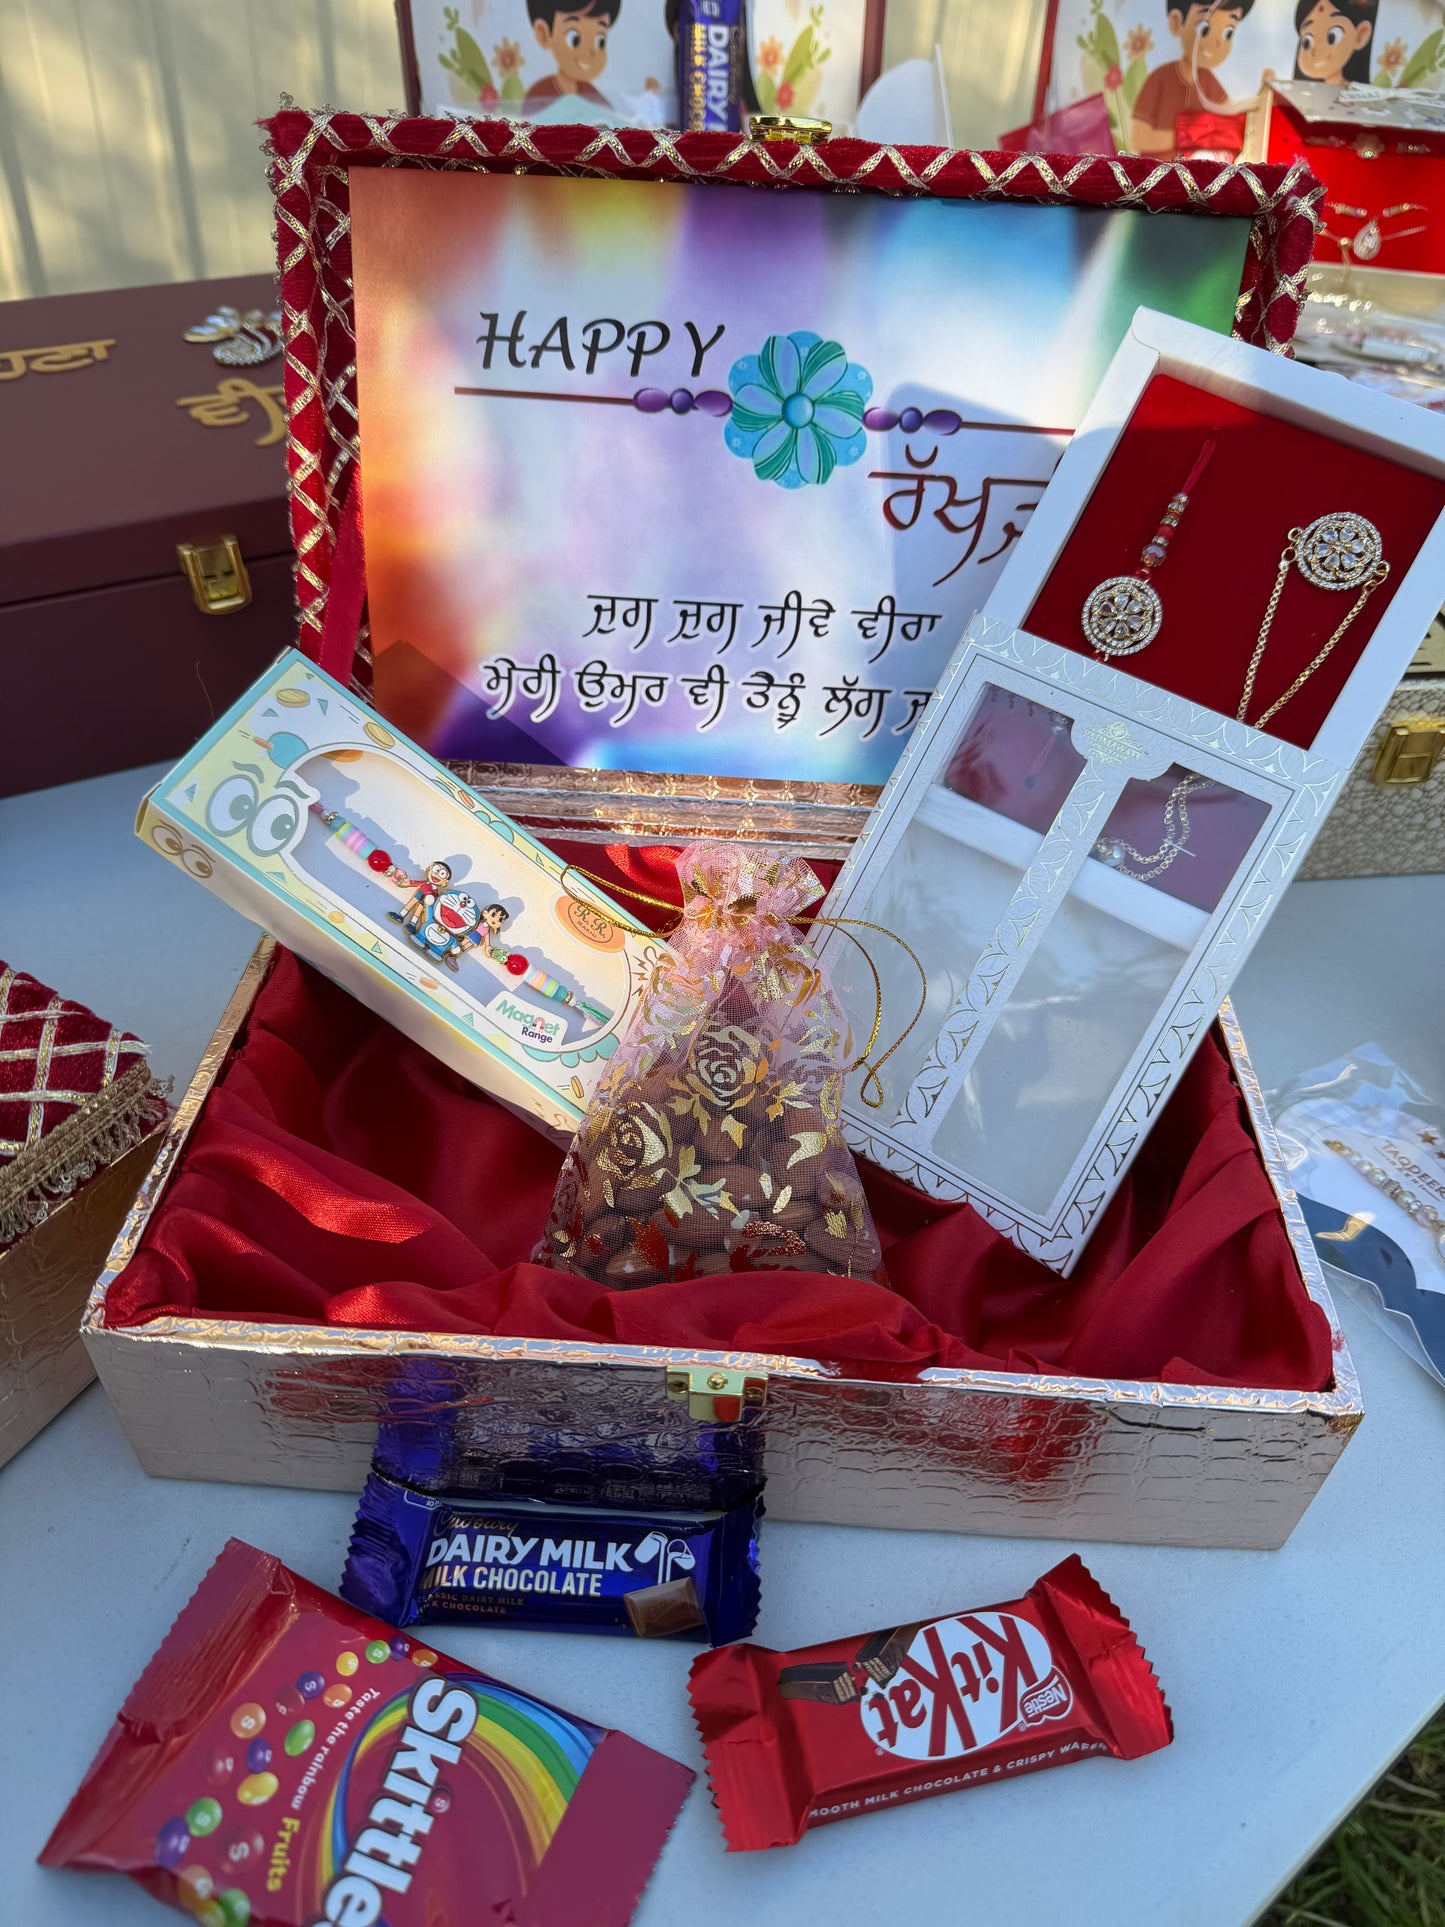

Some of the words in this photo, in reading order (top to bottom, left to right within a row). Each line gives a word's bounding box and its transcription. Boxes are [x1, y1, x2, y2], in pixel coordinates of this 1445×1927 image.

[707, 25, 730, 122] DAIRY
[476, 310, 726, 377] HAPPY
[176, 377, 286, 447] ਵੀ
[868, 444, 1065, 587] ਰੱਖ
[751, 590, 836, 659] ਜੀਵੇ
[851, 595, 943, 664] ਵੀਰਾ
[483, 653, 562, 718] ਮੇਰੀ
[575, 660, 669, 724] ਉਮਰ
[681, 664, 730, 729] ਵੀ
[819, 675, 892, 738] ਲੱਗ
[495, 999, 561, 1036] Magnet
[521, 1026, 554, 1044] Range
[420, 1565, 469, 1590] MILK
[473, 1566, 604, 1597] CHOCOLATE
[426, 1533, 539, 1567] DAIRY
[539, 1538, 634, 1572] MILK
[442, 1601, 507, 1614] CHOCOLATE
[326, 1721, 349, 1746] the
[344, 1687, 381, 1721] Taste
[291, 1745, 330, 1811] rainbow
[311, 1678, 478, 1927] Skittle
[808, 1800, 860, 1818] MOOTH
[864, 1791, 899, 1806] MILK
[903, 1767, 988, 1794] CHOCOLATE
[993, 1764, 1002, 1773] &
[1006, 1749, 1056, 1769] CRISPY
[266, 1816, 301, 1893] Fruits
